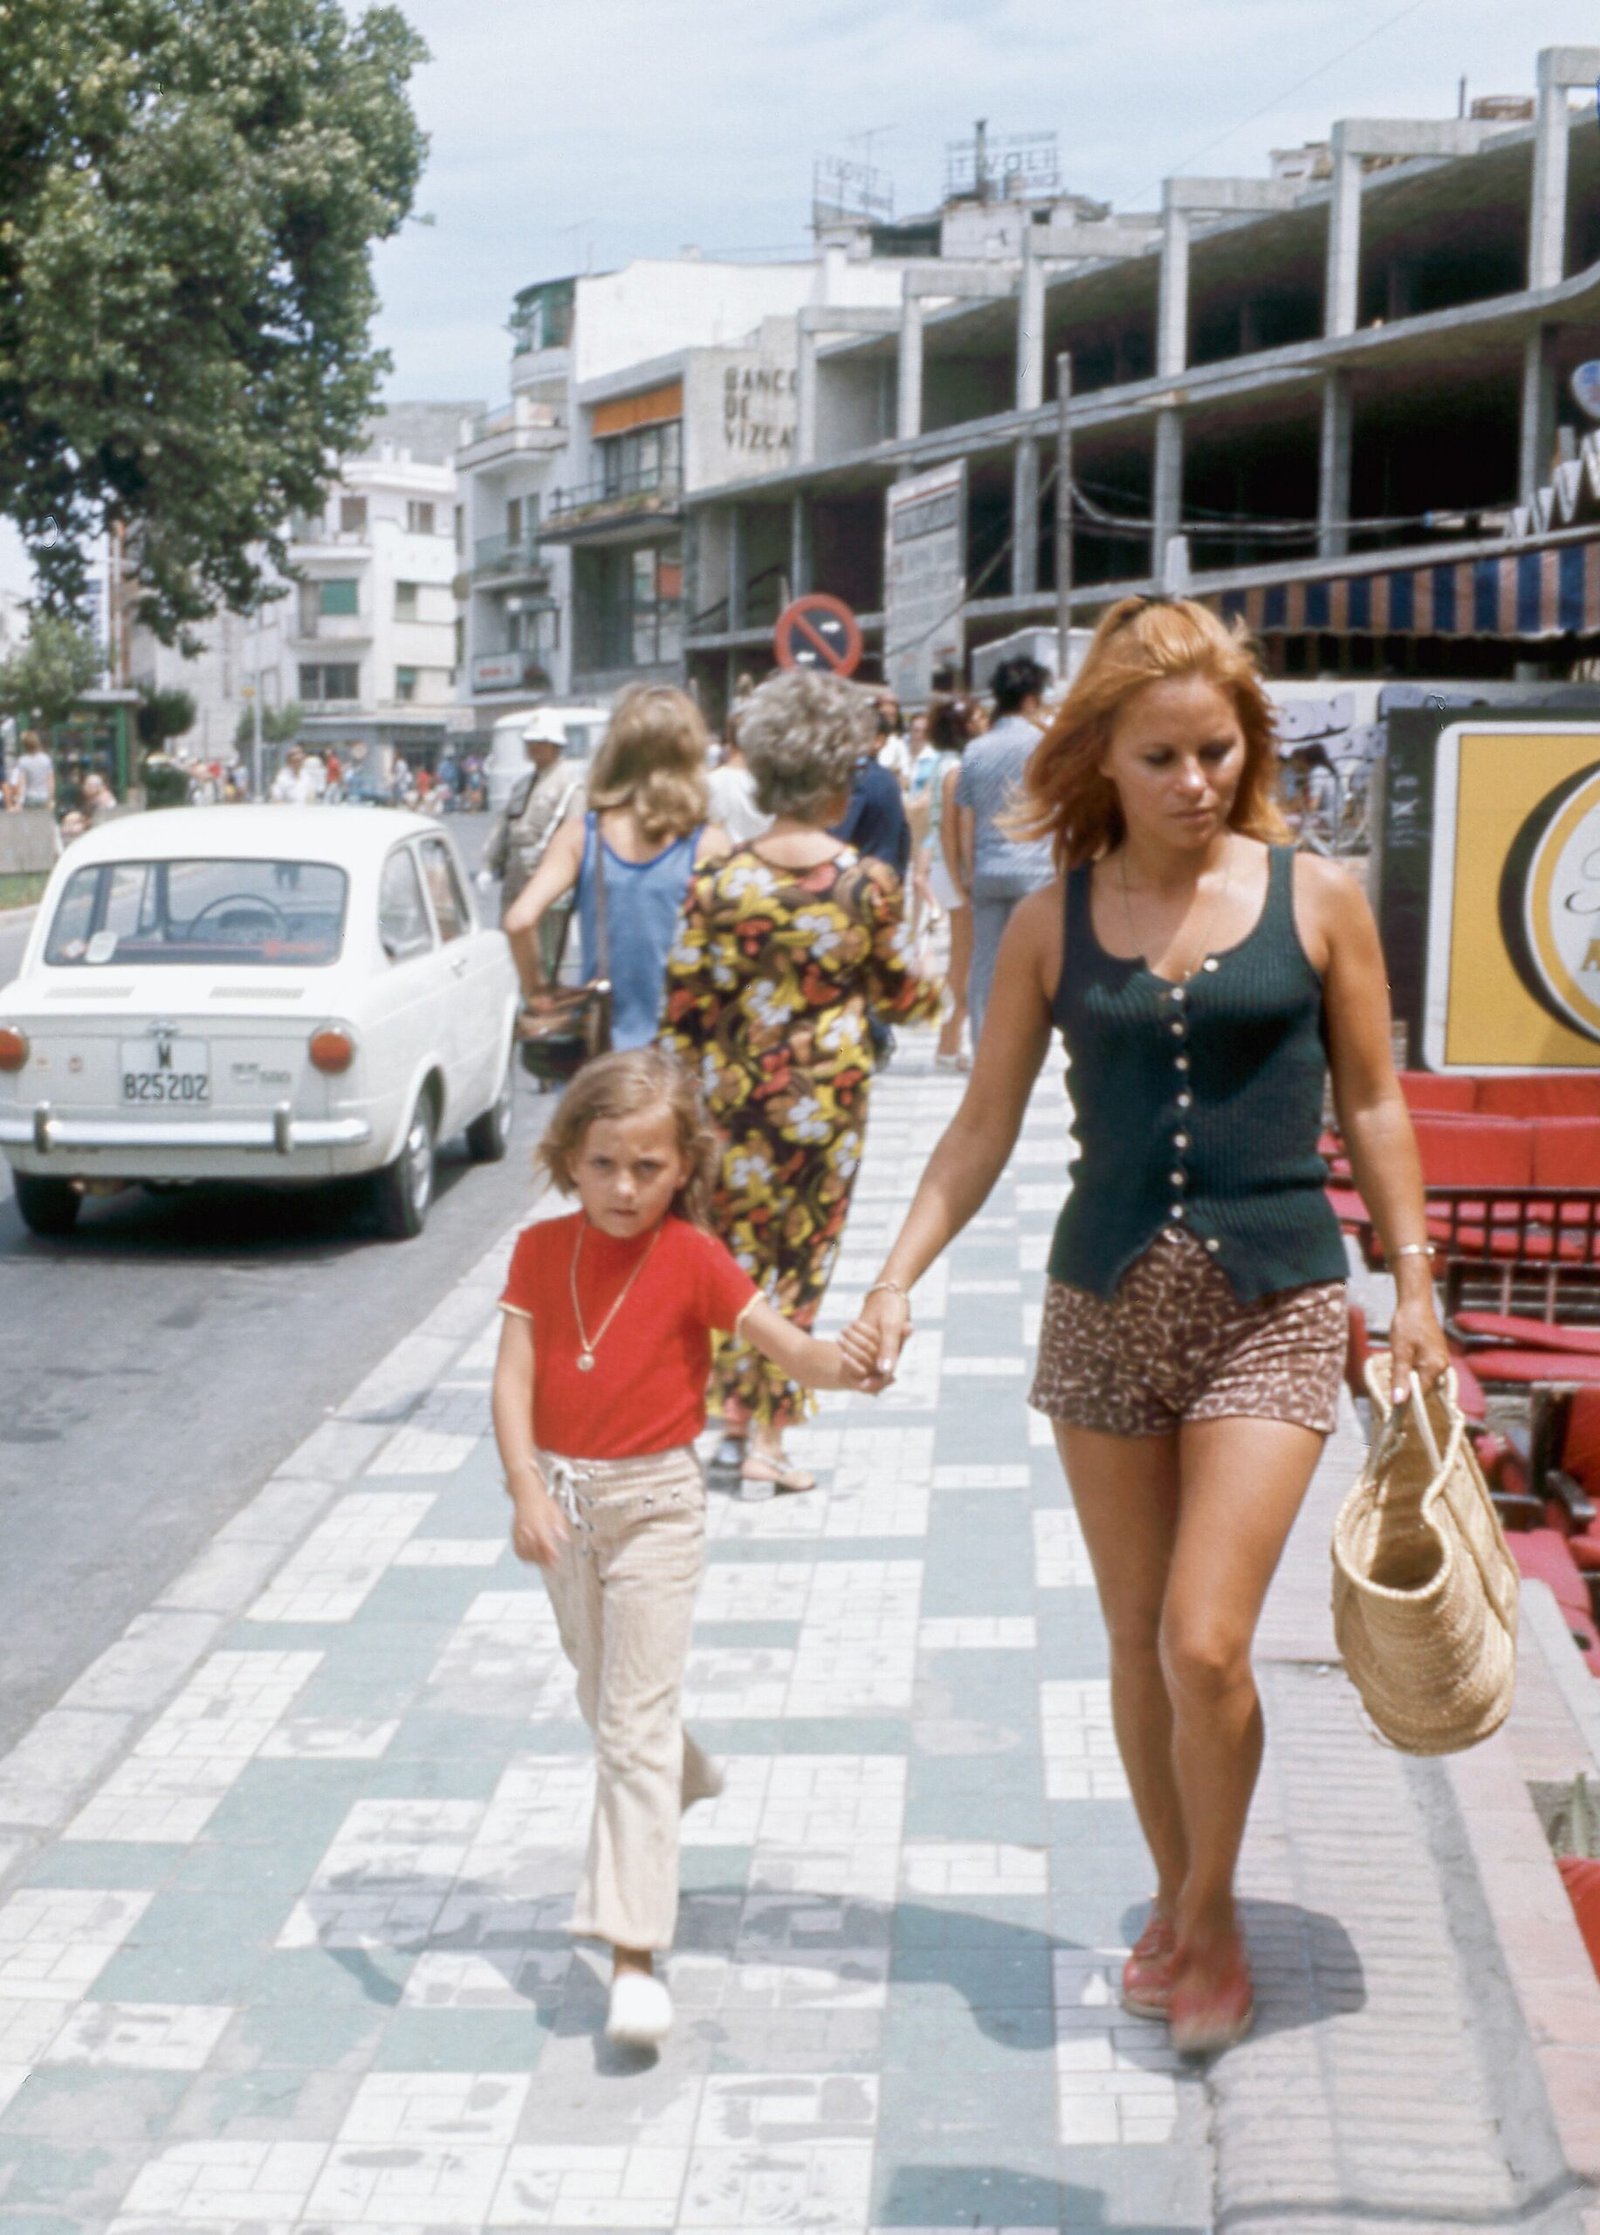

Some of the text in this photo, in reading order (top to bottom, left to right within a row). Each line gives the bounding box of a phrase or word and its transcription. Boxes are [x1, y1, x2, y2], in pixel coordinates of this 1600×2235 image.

[954, 147, 1051, 179] TVOLI
[724, 394, 750, 420] DE
[724, 424, 798, 453] VIZCA
